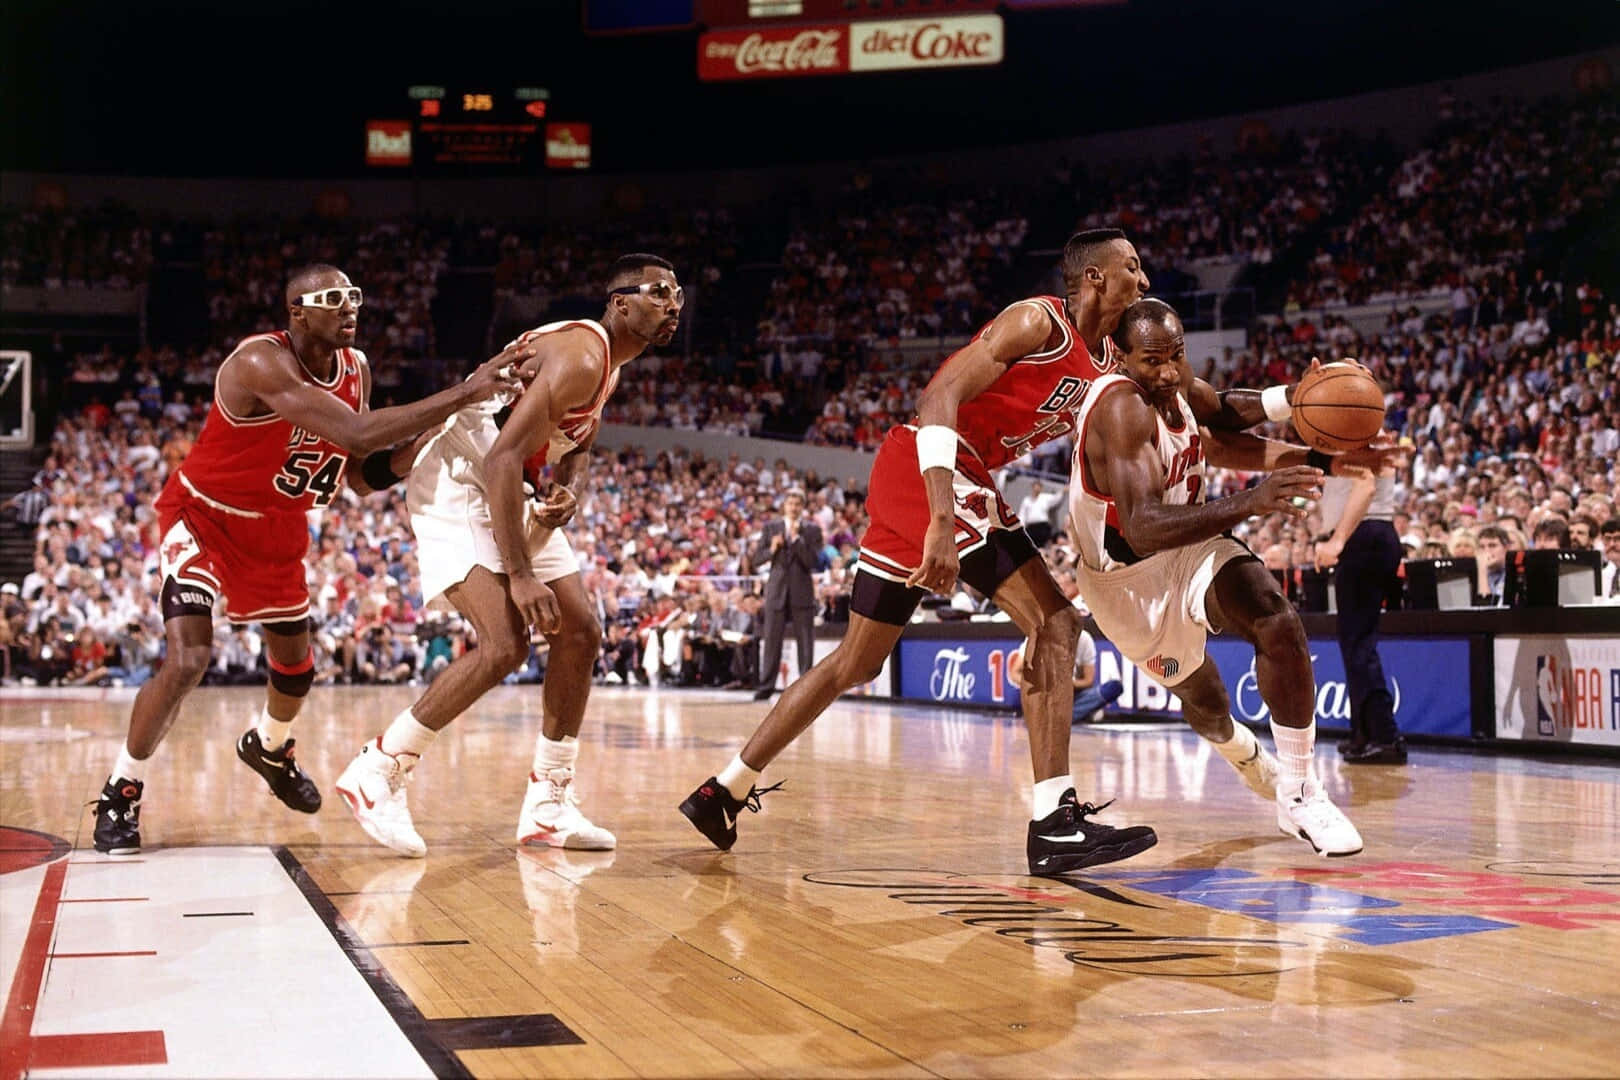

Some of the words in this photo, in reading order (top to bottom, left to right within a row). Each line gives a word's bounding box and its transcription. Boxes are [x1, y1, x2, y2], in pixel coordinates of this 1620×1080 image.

[862, 28, 909, 55] diet
[911, 24, 992, 61] Coke
[272, 450, 347, 508] 54
[930, 646, 976, 701] The
[1562, 667, 1604, 730] NBA
